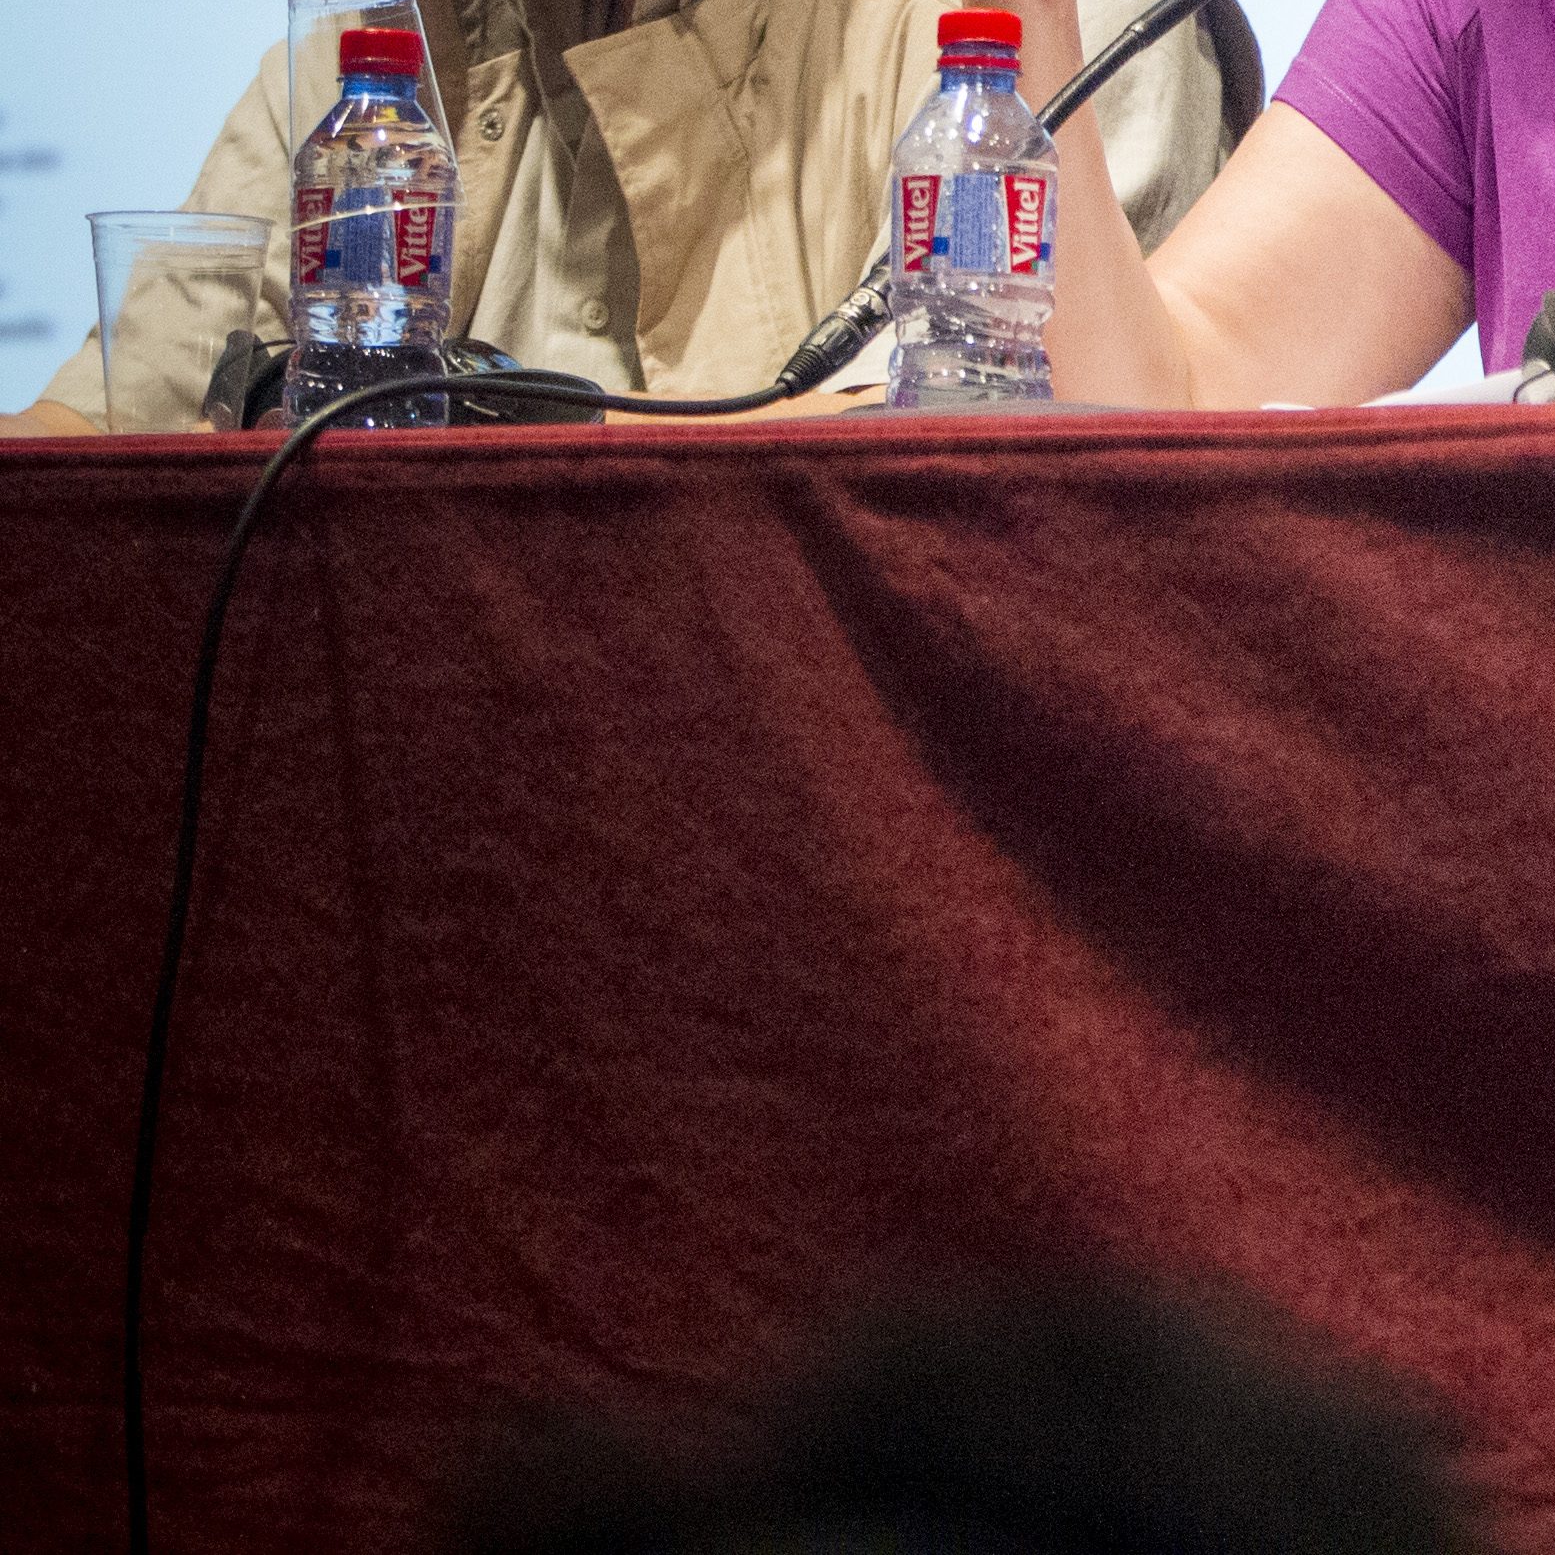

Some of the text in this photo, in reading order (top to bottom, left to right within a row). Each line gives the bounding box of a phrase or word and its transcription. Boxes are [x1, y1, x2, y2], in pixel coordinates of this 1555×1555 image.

[399, 196, 429, 279] Vittel
[902, 179, 931, 265] Vittel
[1012, 181, 1040, 267] Vittel
